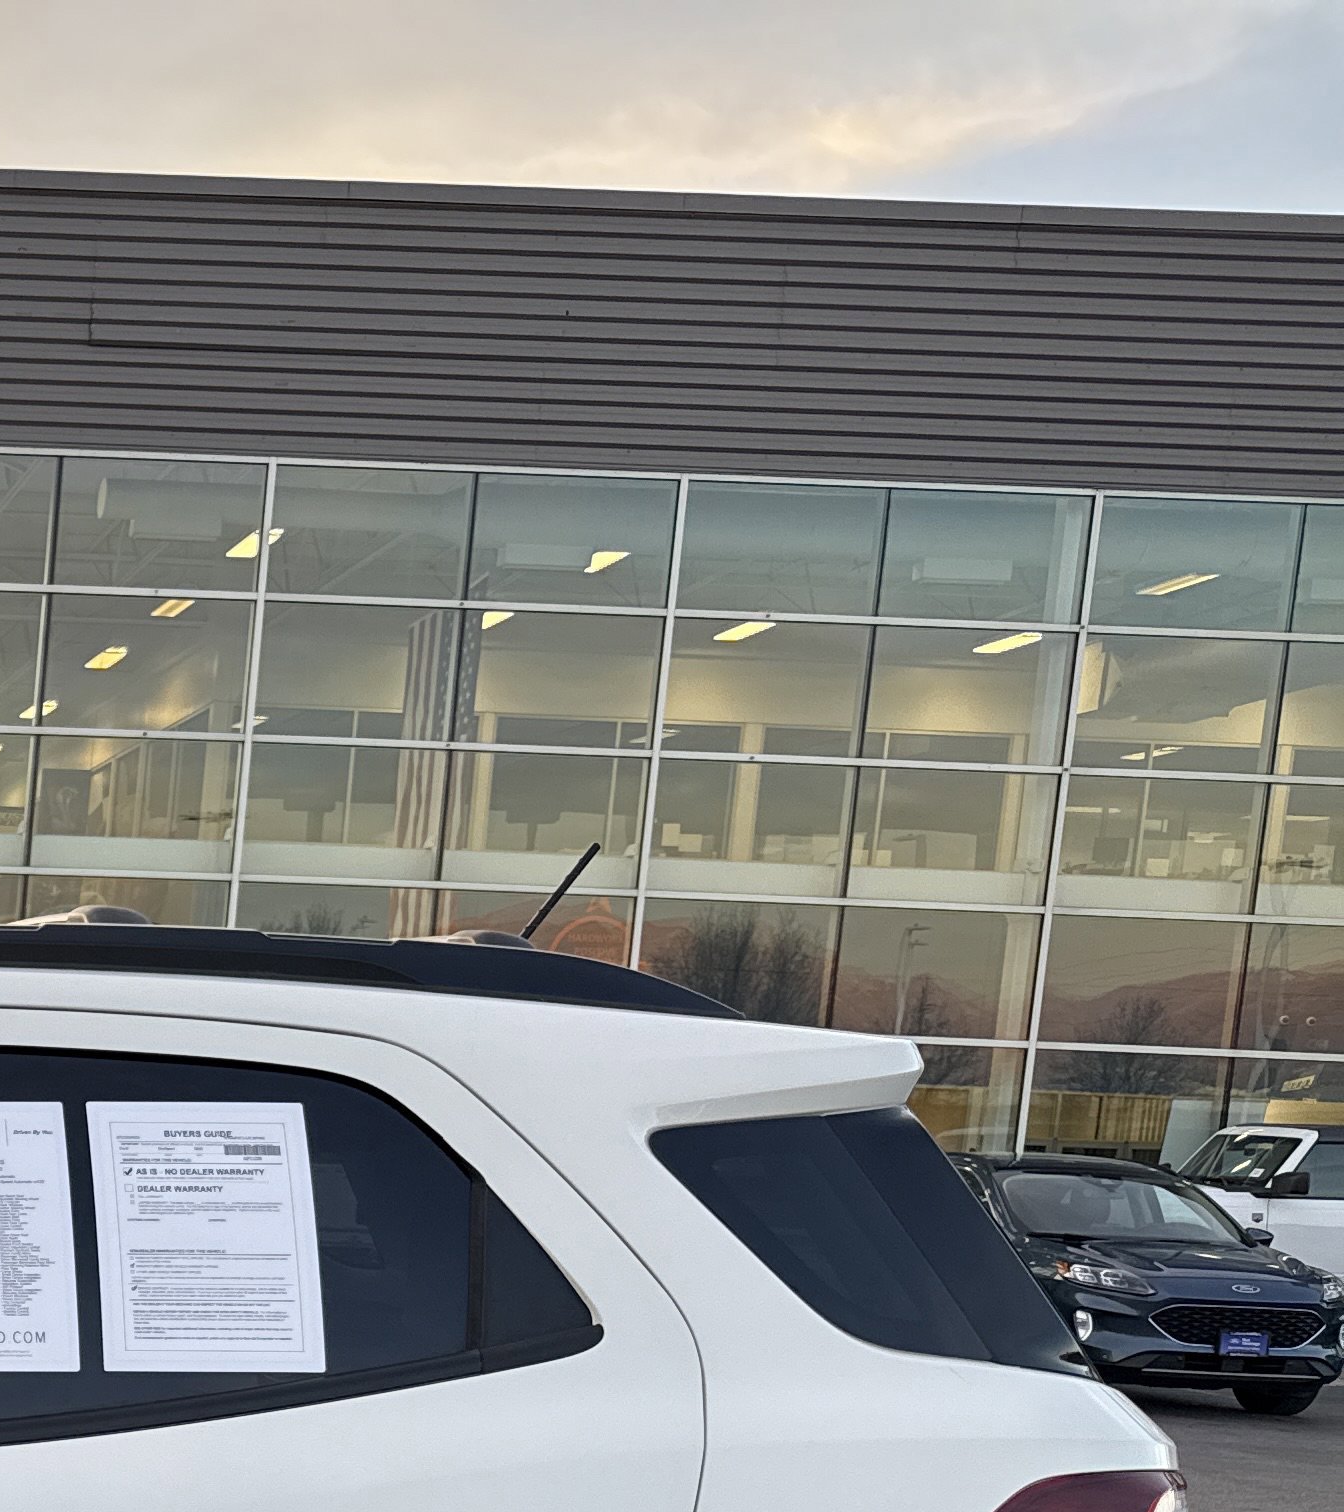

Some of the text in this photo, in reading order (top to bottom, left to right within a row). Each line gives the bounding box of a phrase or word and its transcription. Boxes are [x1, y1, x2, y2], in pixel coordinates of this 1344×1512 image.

[163, 1130, 202, 1138] BUYERS
[204, 1130, 233, 1138] GUIDE
[164, 1168, 178, 1176] NO
[179, 1168, 214, 1176] DEALER
[215, 1168, 265, 1176] WARRANTY
[137, 1185, 224, 1193] DEALER WARRANTY
